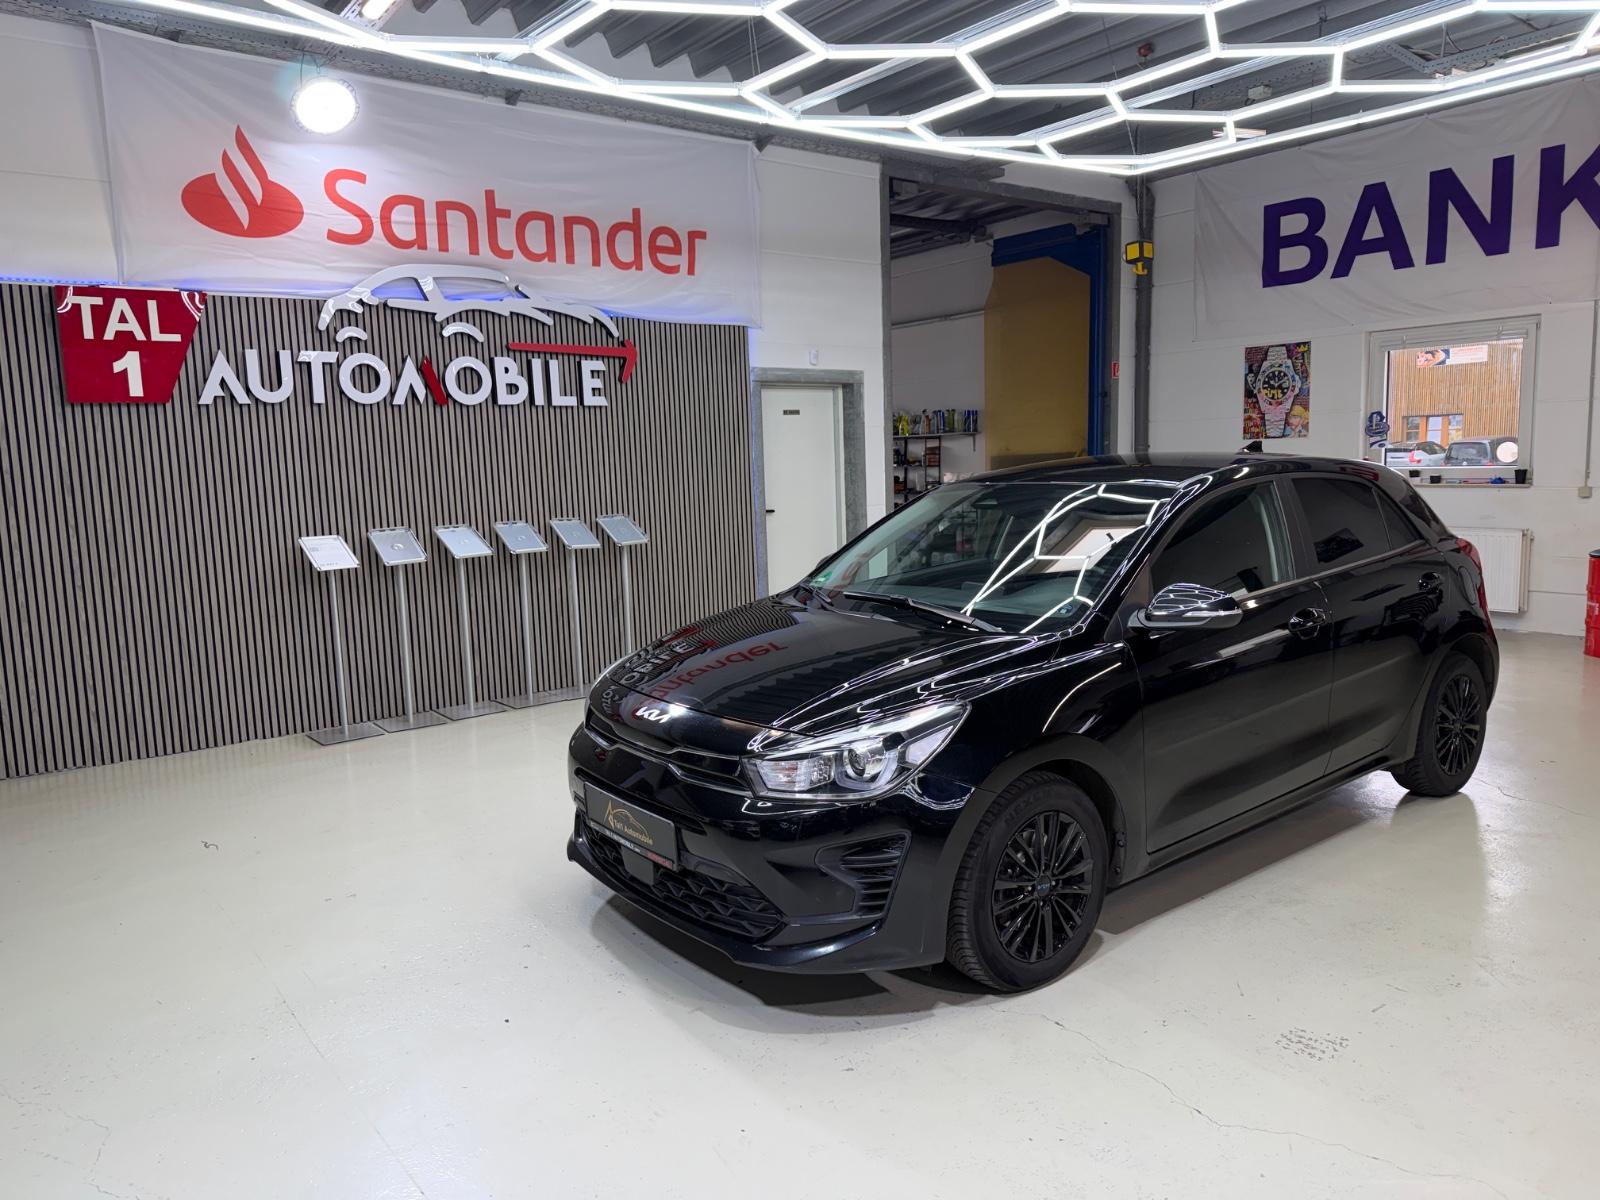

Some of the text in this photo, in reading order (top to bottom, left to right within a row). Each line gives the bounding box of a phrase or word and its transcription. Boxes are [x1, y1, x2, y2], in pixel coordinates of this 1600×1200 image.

[323, 168, 707, 276] Santander
[1262, 143, 1600, 289] BANK
[66, 294, 182, 342] TAL
[112, 351, 144, 397] 1
[198, 348, 609, 407] AUTOMOBILE
[635, 706, 672, 724] KIA
